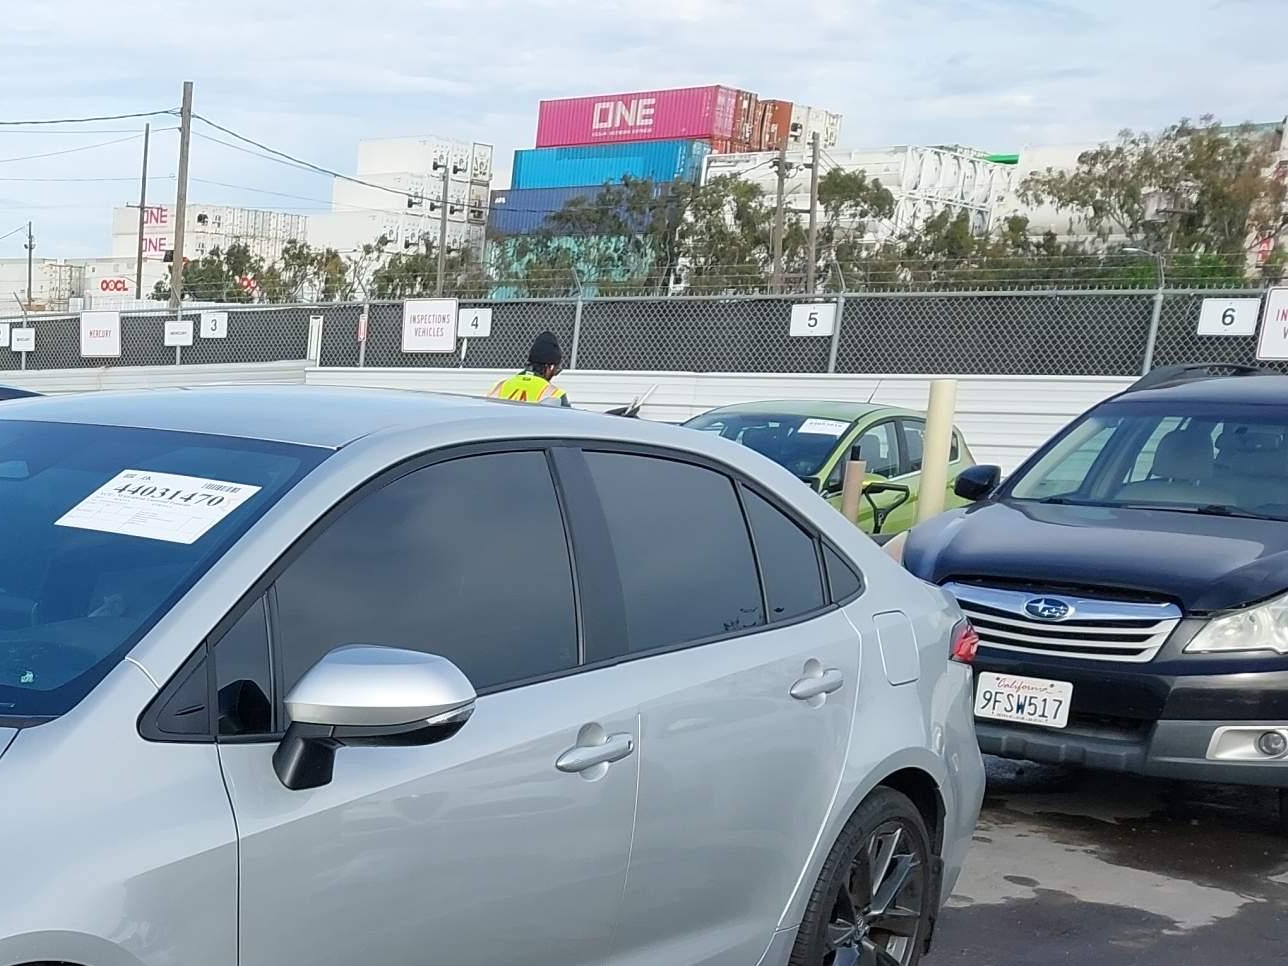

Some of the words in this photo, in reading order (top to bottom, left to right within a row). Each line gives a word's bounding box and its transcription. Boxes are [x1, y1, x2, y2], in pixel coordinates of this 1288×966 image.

[592, 98, 656, 129] ONE
[101, 279, 128, 291] OOCL
[409, 313, 451, 325] INSPECTIONS
[471, 316, 479, 329] 4
[807, 312, 818, 328] 5
[1222, 307, 1236, 326] 6
[210, 318, 217, 331] 3
[414, 327, 445, 337] VEHICLES
[113, 483, 225, 507] 44031470
[980, 690, 1063, 720] 9FSW517
